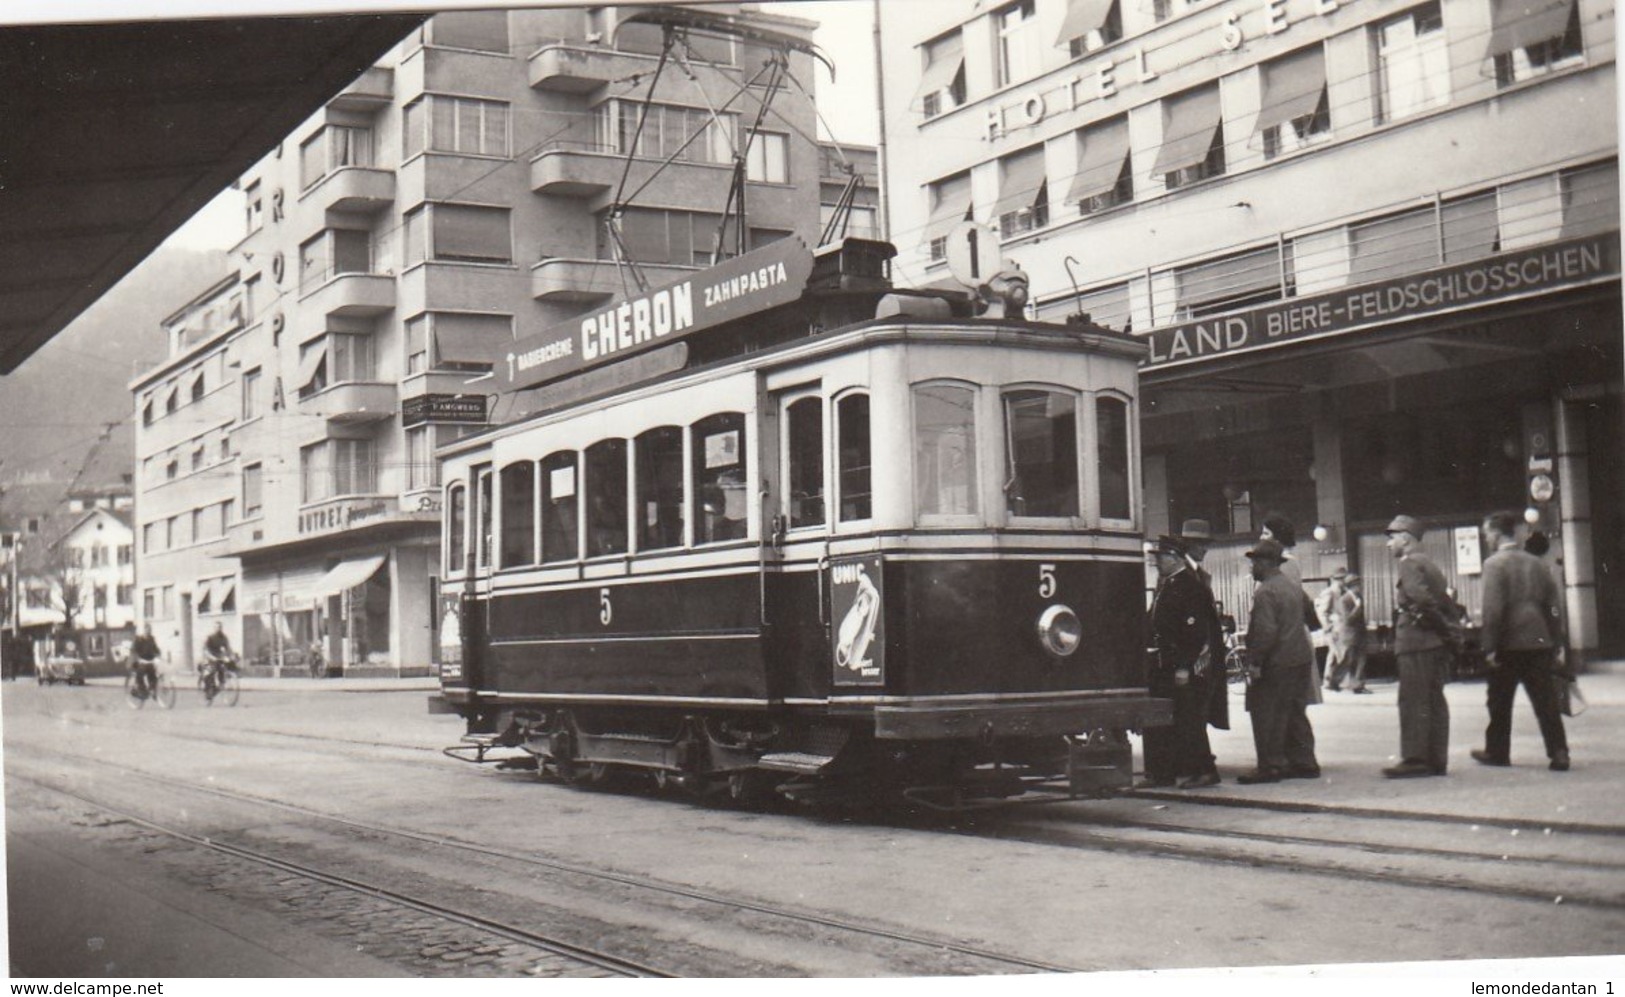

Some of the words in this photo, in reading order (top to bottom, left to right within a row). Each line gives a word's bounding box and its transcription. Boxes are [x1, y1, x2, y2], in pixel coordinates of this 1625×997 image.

[988, 49, 1160, 143] HOTEL
[966, 227, 980, 280] 1
[581, 281, 694, 361] CHÉRON
[704, 262, 787, 307] ZAHNPASTA
[1138, 316, 1249, 367] LAND
[832, 563, 865, 585] UNIC
[1038, 564, 1057, 599] 5
[600, 588, 612, 626] 5
